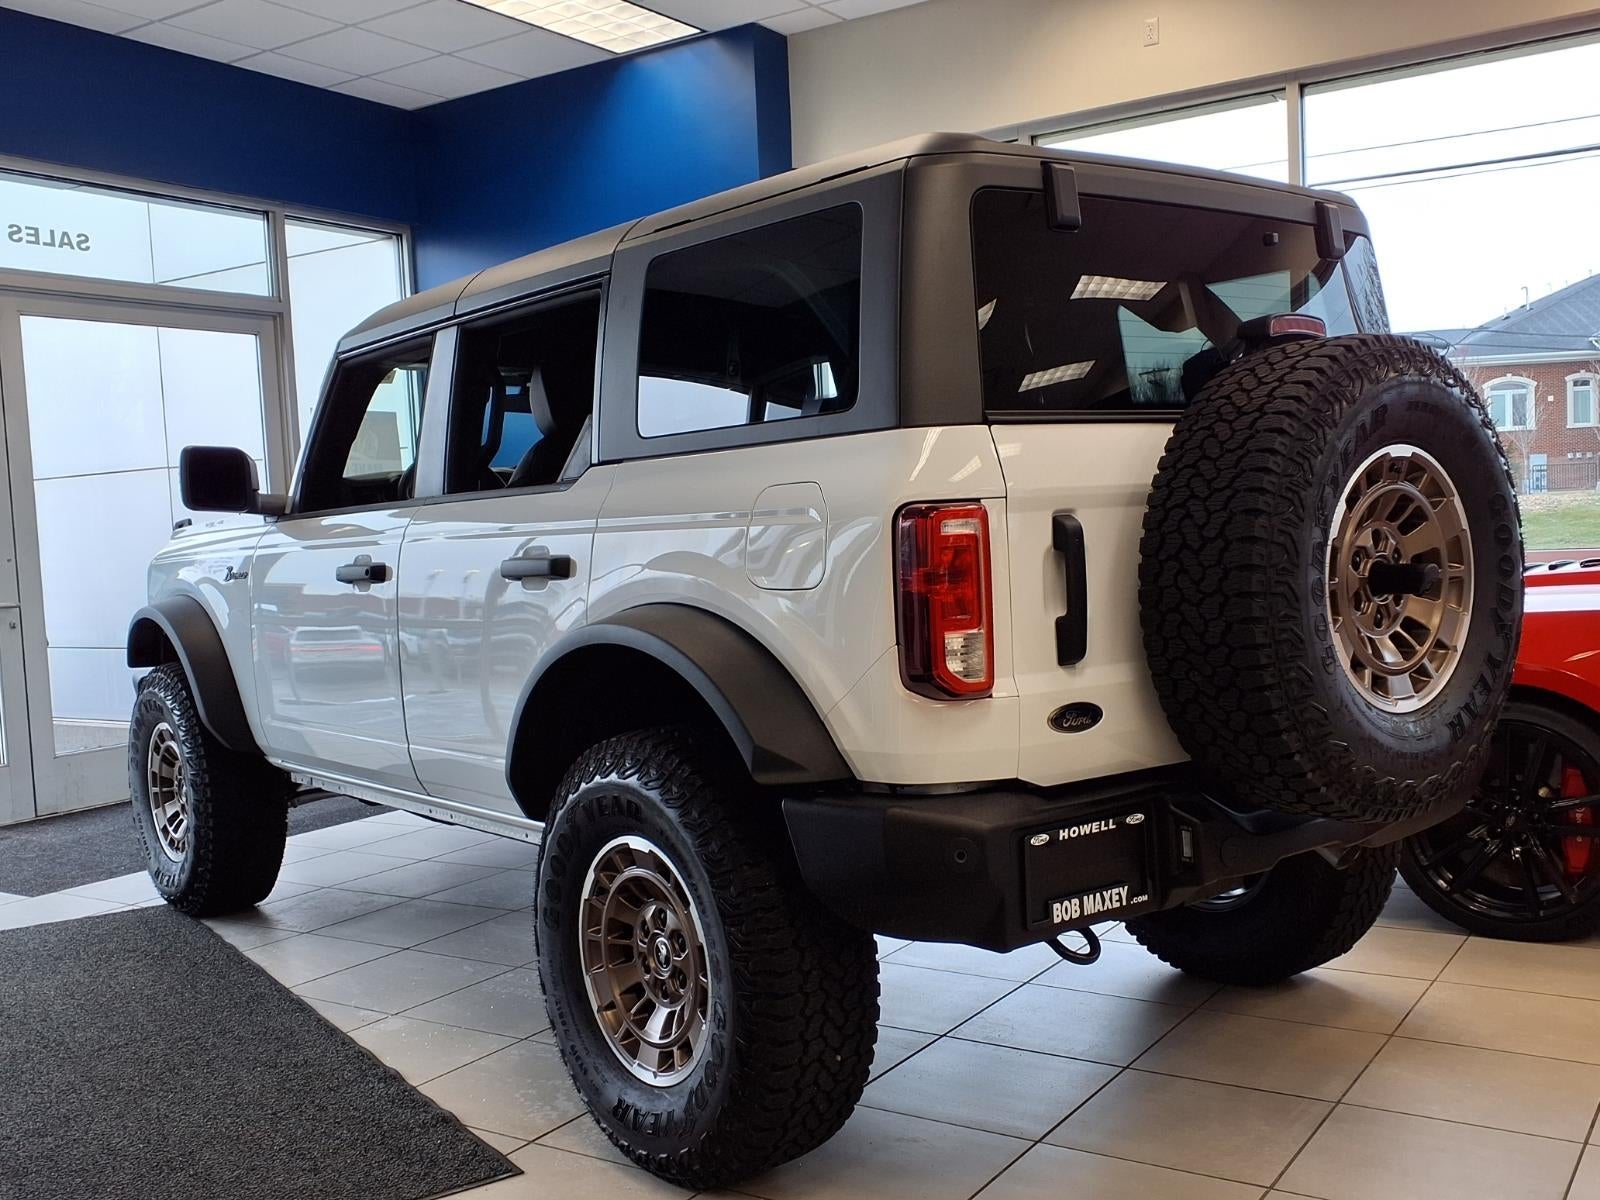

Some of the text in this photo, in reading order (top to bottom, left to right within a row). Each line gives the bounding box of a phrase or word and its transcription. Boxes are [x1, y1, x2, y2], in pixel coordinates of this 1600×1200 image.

[1031, 813, 1145, 845] Ford HOWELL Ford
[1052, 897, 1081, 924] BOB
[1083, 885, 1129, 916] MAXEY
